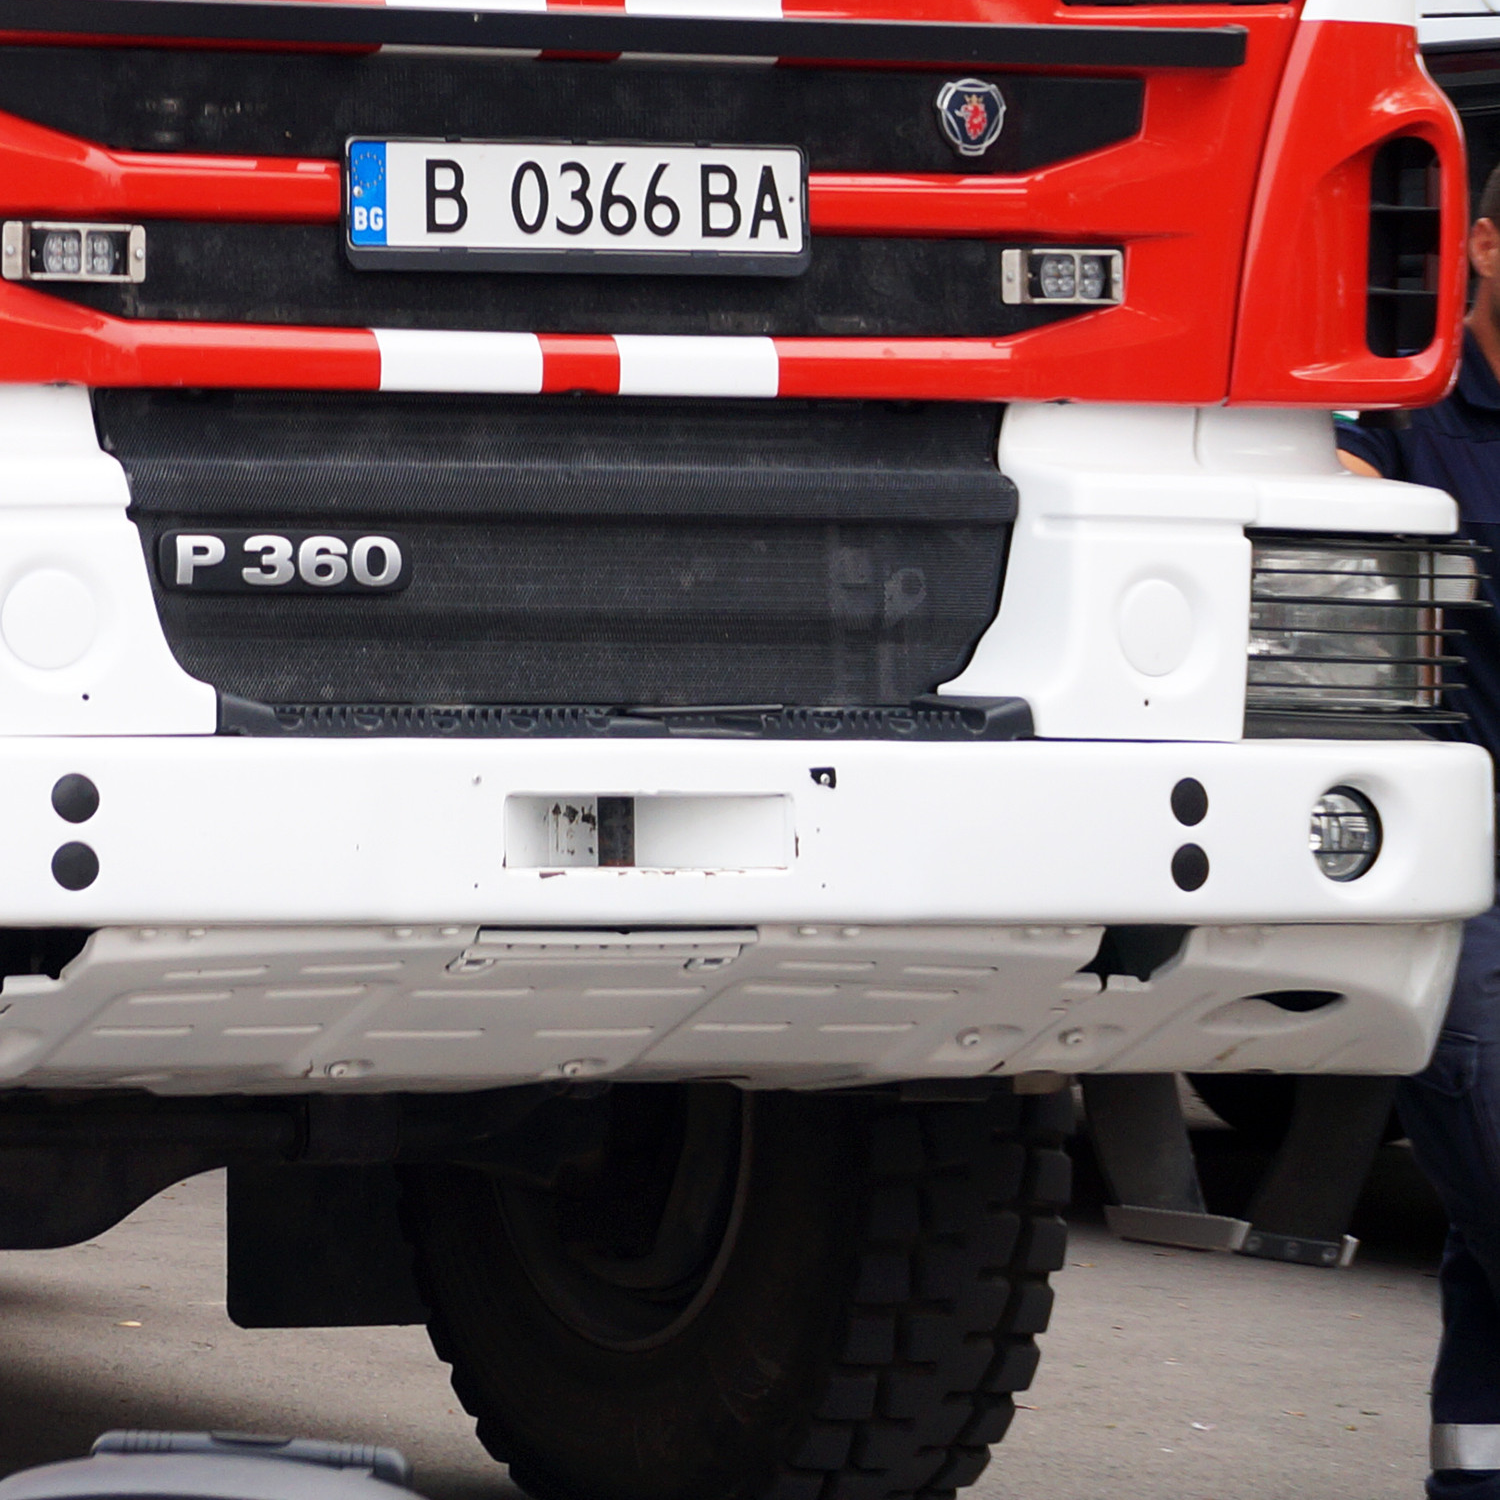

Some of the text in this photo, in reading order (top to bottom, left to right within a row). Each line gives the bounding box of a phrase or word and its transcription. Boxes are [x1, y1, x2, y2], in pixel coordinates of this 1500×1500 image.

[353, 208, 384, 231] BG
[425, 158, 788, 240] B 0366 BA
[176, 534, 402, 588] P 360
